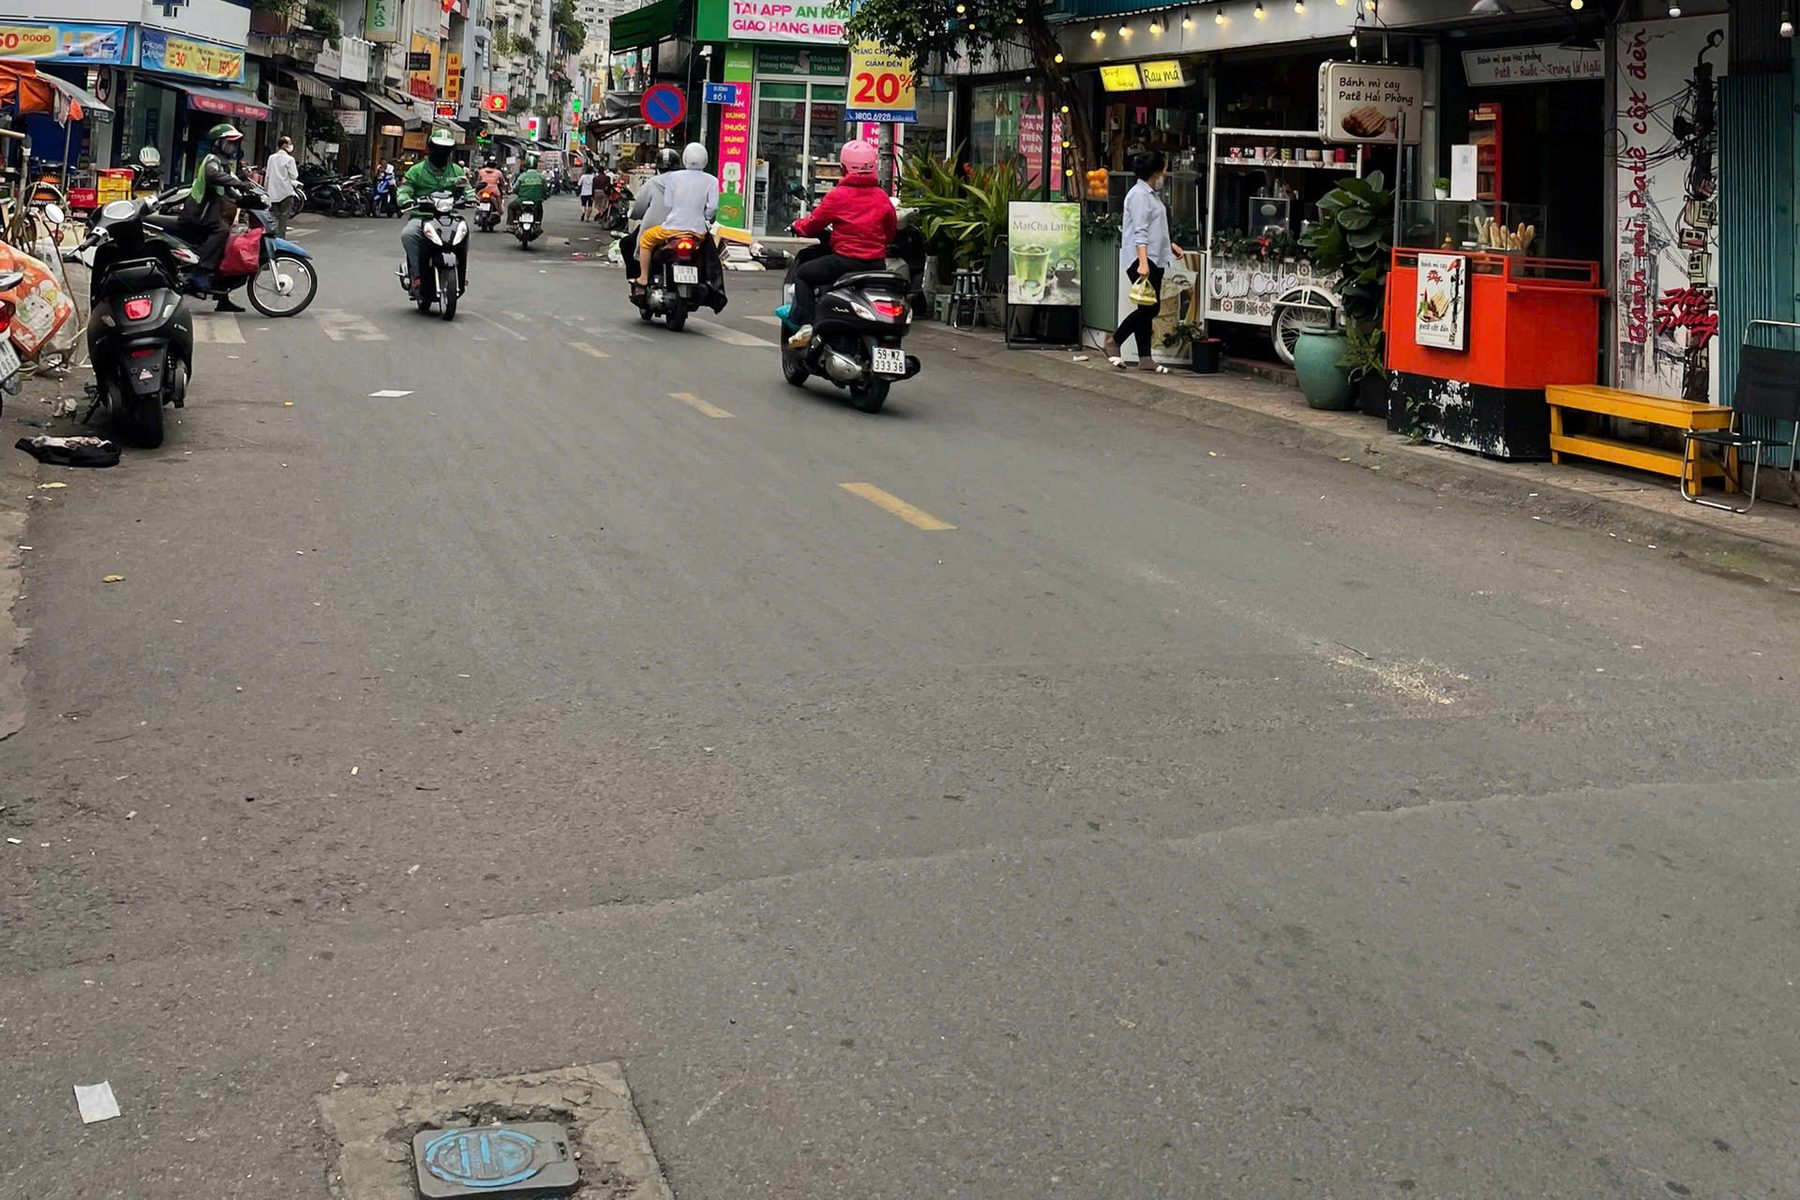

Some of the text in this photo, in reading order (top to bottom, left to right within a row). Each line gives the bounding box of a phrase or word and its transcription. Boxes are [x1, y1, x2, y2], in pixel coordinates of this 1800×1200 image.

[760, 3, 792, 17] APP
[795, 6, 818, 19] AN
[732, 19, 766, 32] GIAO
[1627, 28, 1648, 80] đèn
[1143, 64, 1179, 83] Rau má
[1339, 76, 1400, 92] Bánh mì cay
[1338, 90, 1414, 107] Patê Hải Phòng
[1626, 146, 1648, 208] Patê
[1013, 221, 1073, 232] MatCha Latte
